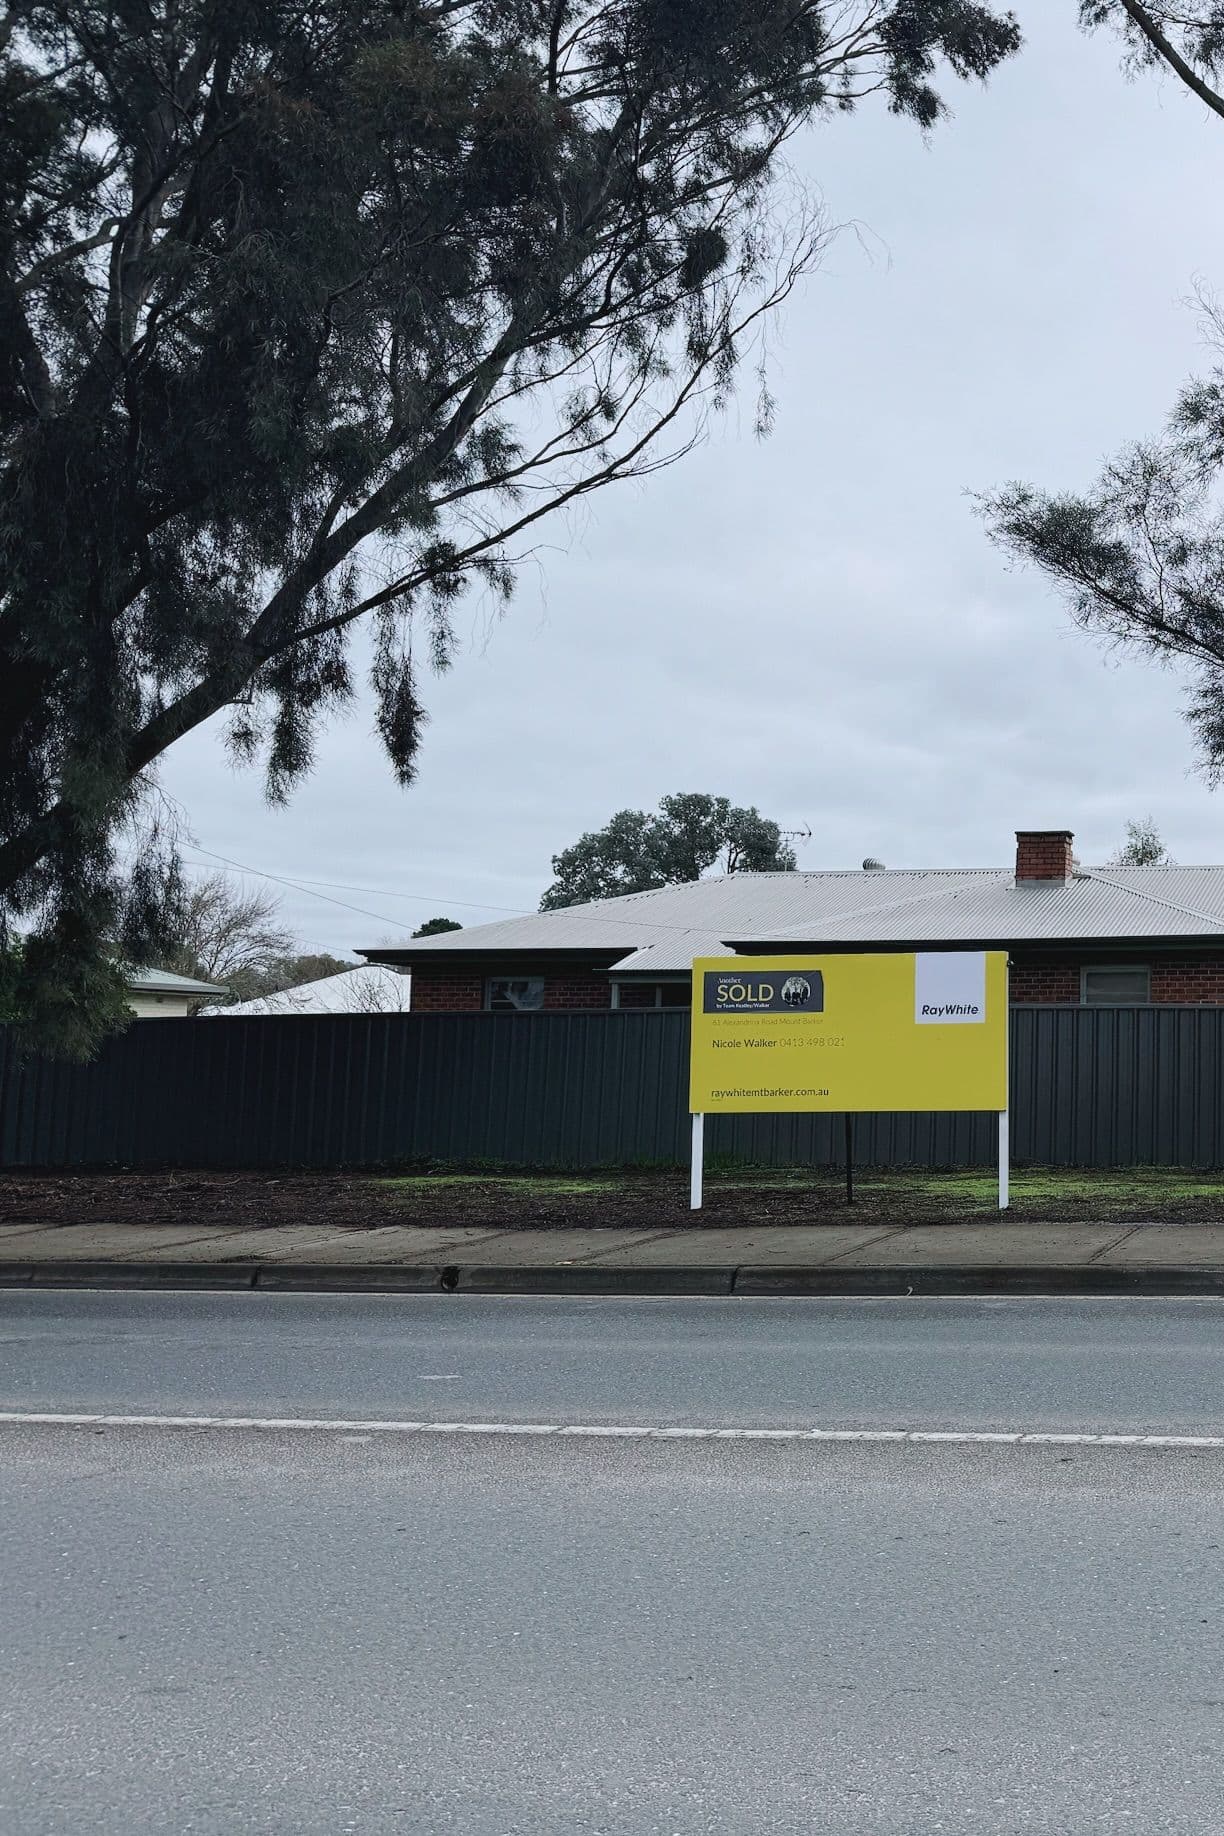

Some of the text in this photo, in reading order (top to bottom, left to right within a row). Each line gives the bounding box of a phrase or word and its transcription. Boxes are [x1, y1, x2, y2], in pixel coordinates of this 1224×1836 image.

[716, 984, 774, 1002] SOLD
[921, 1004, 979, 1017] RayWhite
[712, 1039, 742, 1048] Nicole
[744, 1038, 777, 1048] Walker
[779, 1038, 804, 1047] 0413
[806, 1037, 826, 1047] 498
[711, 1088, 829, 1098] raywhitemtbarker.com.au
